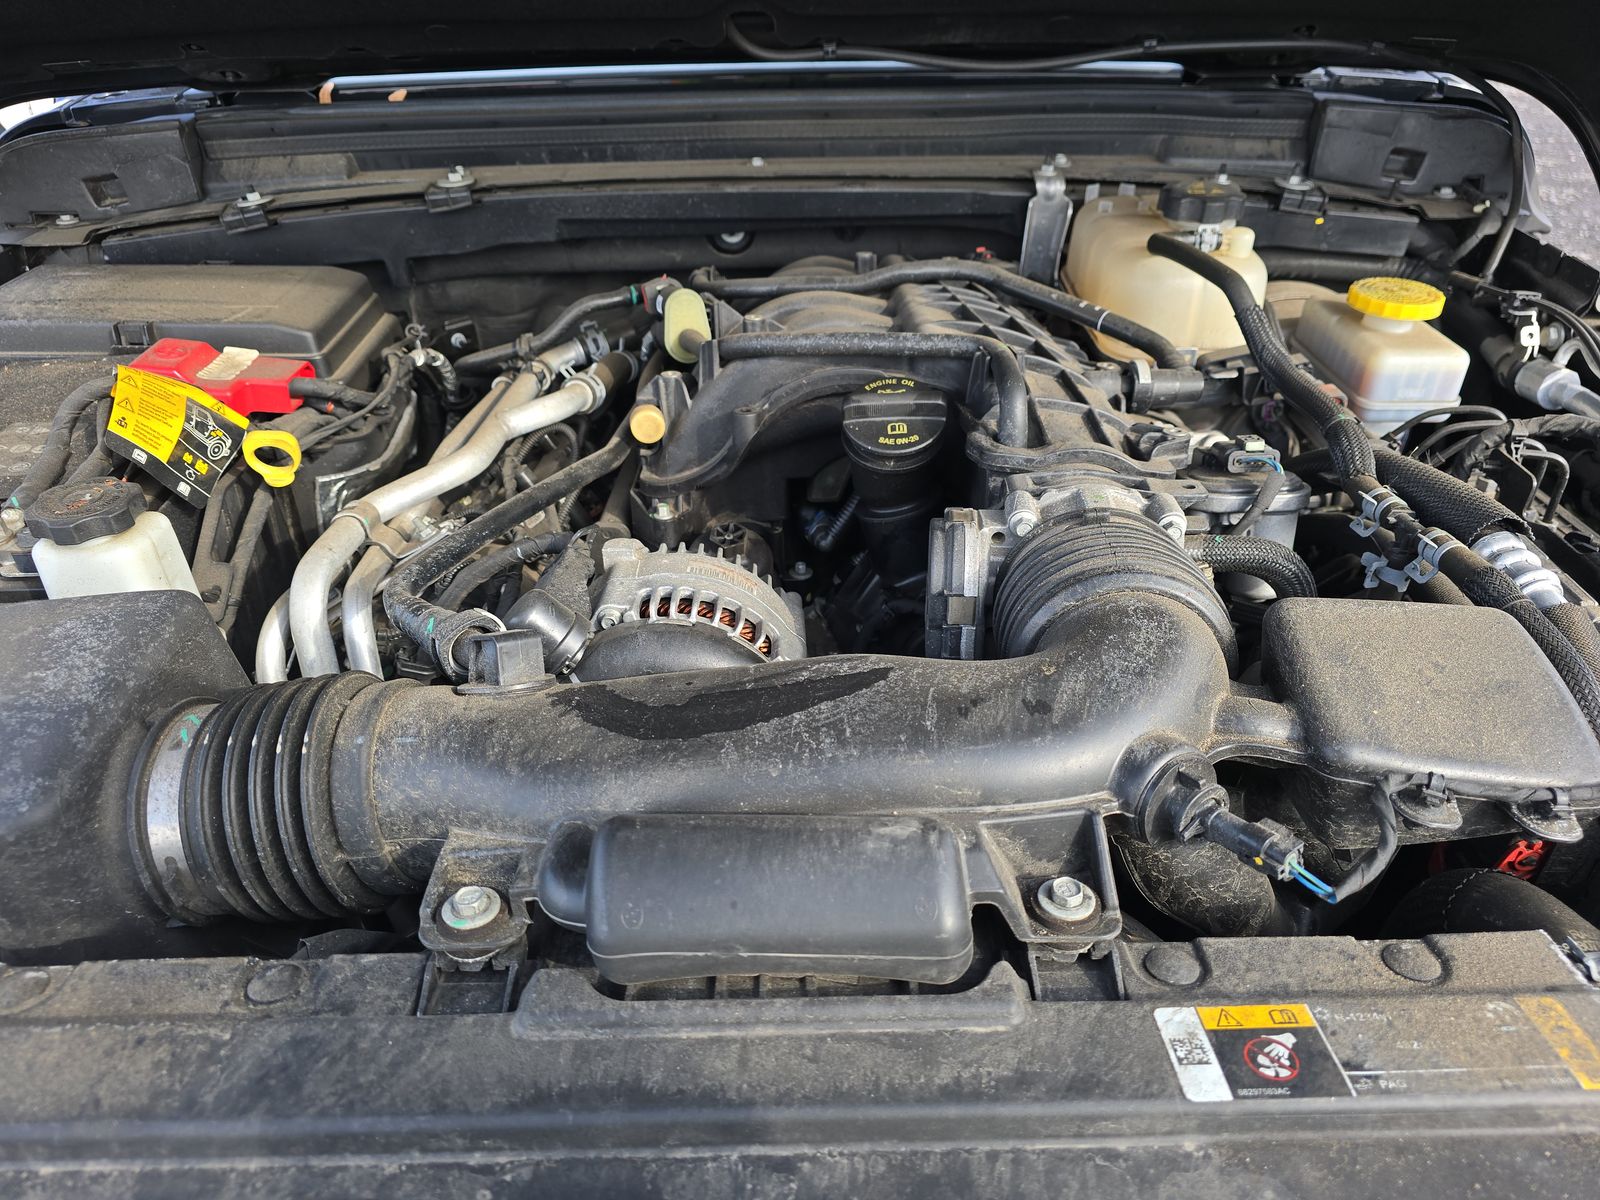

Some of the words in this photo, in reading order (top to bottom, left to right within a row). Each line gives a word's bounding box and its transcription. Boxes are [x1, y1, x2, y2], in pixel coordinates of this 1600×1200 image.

[864, 378, 898, 392] ENGINE
[901, 379, 915, 388] OIL
[878, 436, 896, 445] SAE
[895, 434, 919, 445] 0W-20
